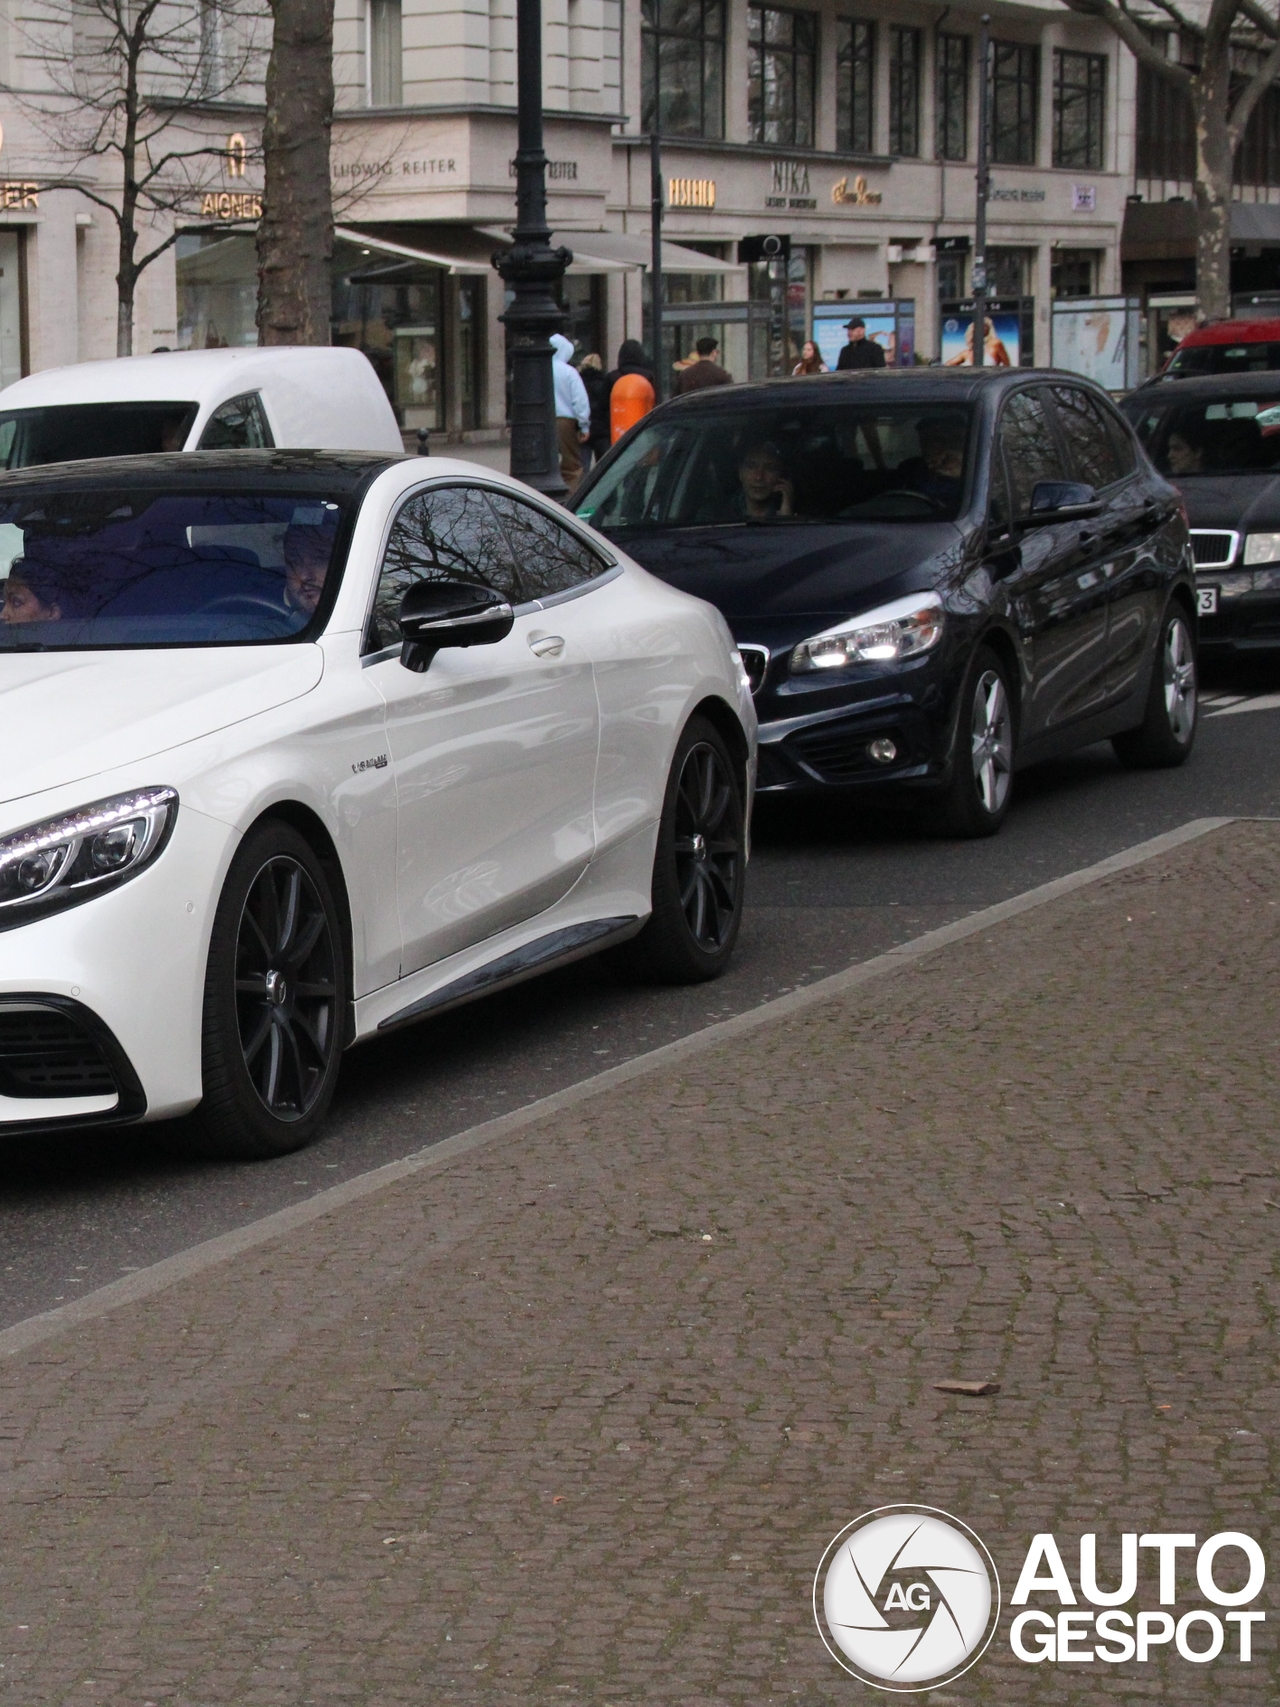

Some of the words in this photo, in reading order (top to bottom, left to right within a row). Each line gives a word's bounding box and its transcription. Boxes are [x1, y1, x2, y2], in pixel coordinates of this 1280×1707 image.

[333, 161, 393, 178] LUDWIG
[402, 159, 457, 176] REITER
[770, 161, 811, 194] NIKA
[201, 193, 263, 218] AIGNER
